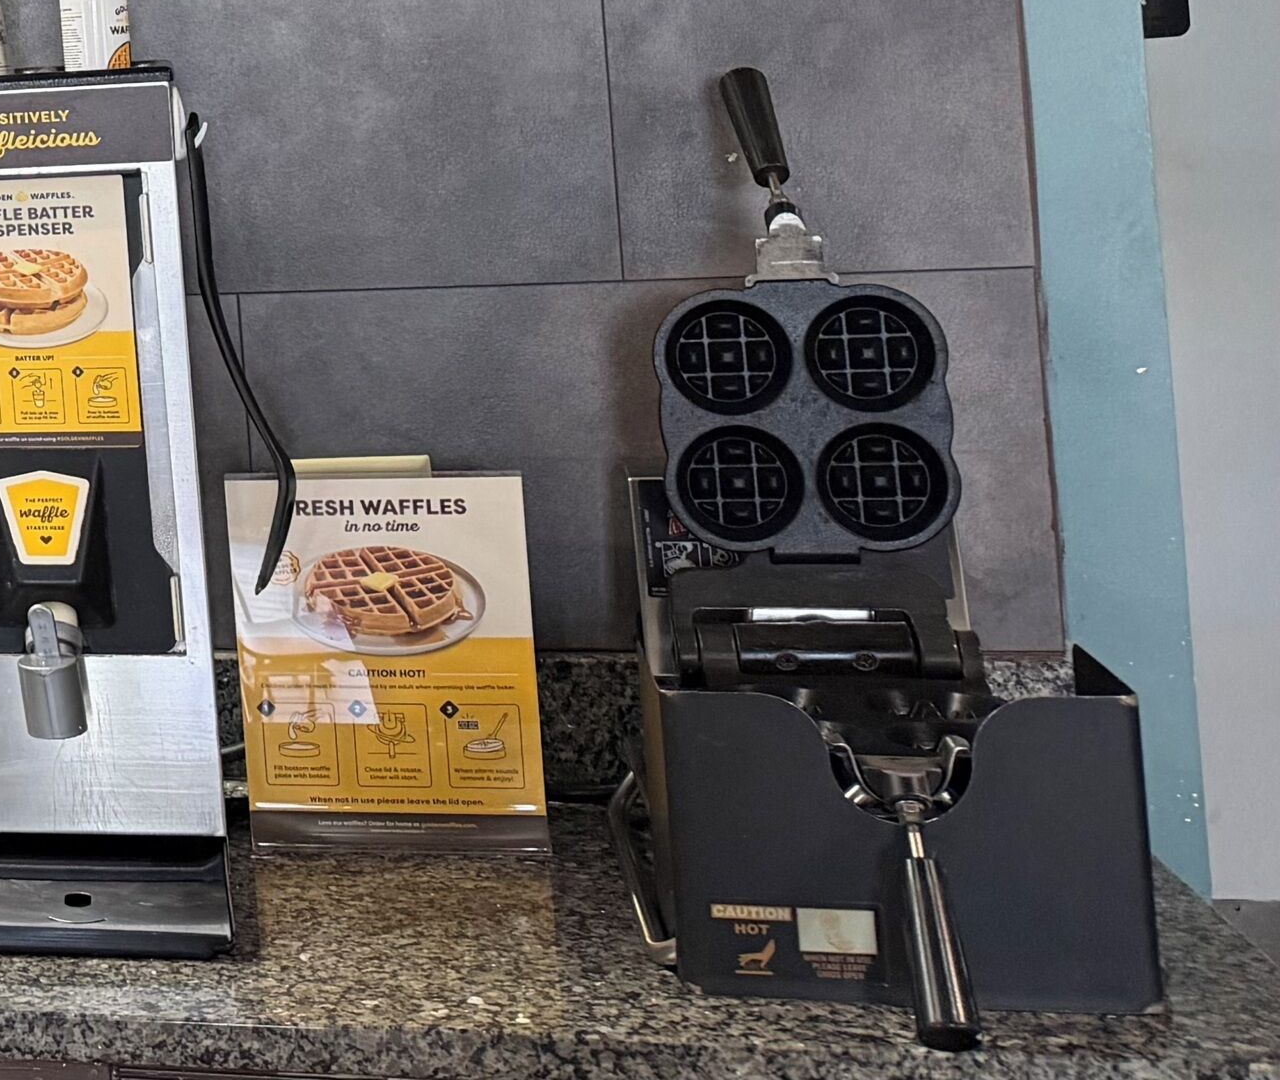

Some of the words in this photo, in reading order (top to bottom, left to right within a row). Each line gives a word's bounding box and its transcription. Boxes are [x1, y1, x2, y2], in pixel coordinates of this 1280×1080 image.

[30, 192, 71, 200] WAFFLES
[28, 205, 94, 220] BATTER
[295, 499, 354, 516] RESH
[360, 498, 467, 516] WAFFLES
[20, 505, 70, 523] waffle
[344, 520, 360, 532] in
[362, 522, 383, 532] no
[385, 520, 420, 532] time
[348, 669, 397, 678] CAUTION
[400, 669, 426, 678] HOT!
[377, 797, 405, 805] please
[712, 905, 790, 920] CAUTION
[734, 924, 770, 936] HOT
